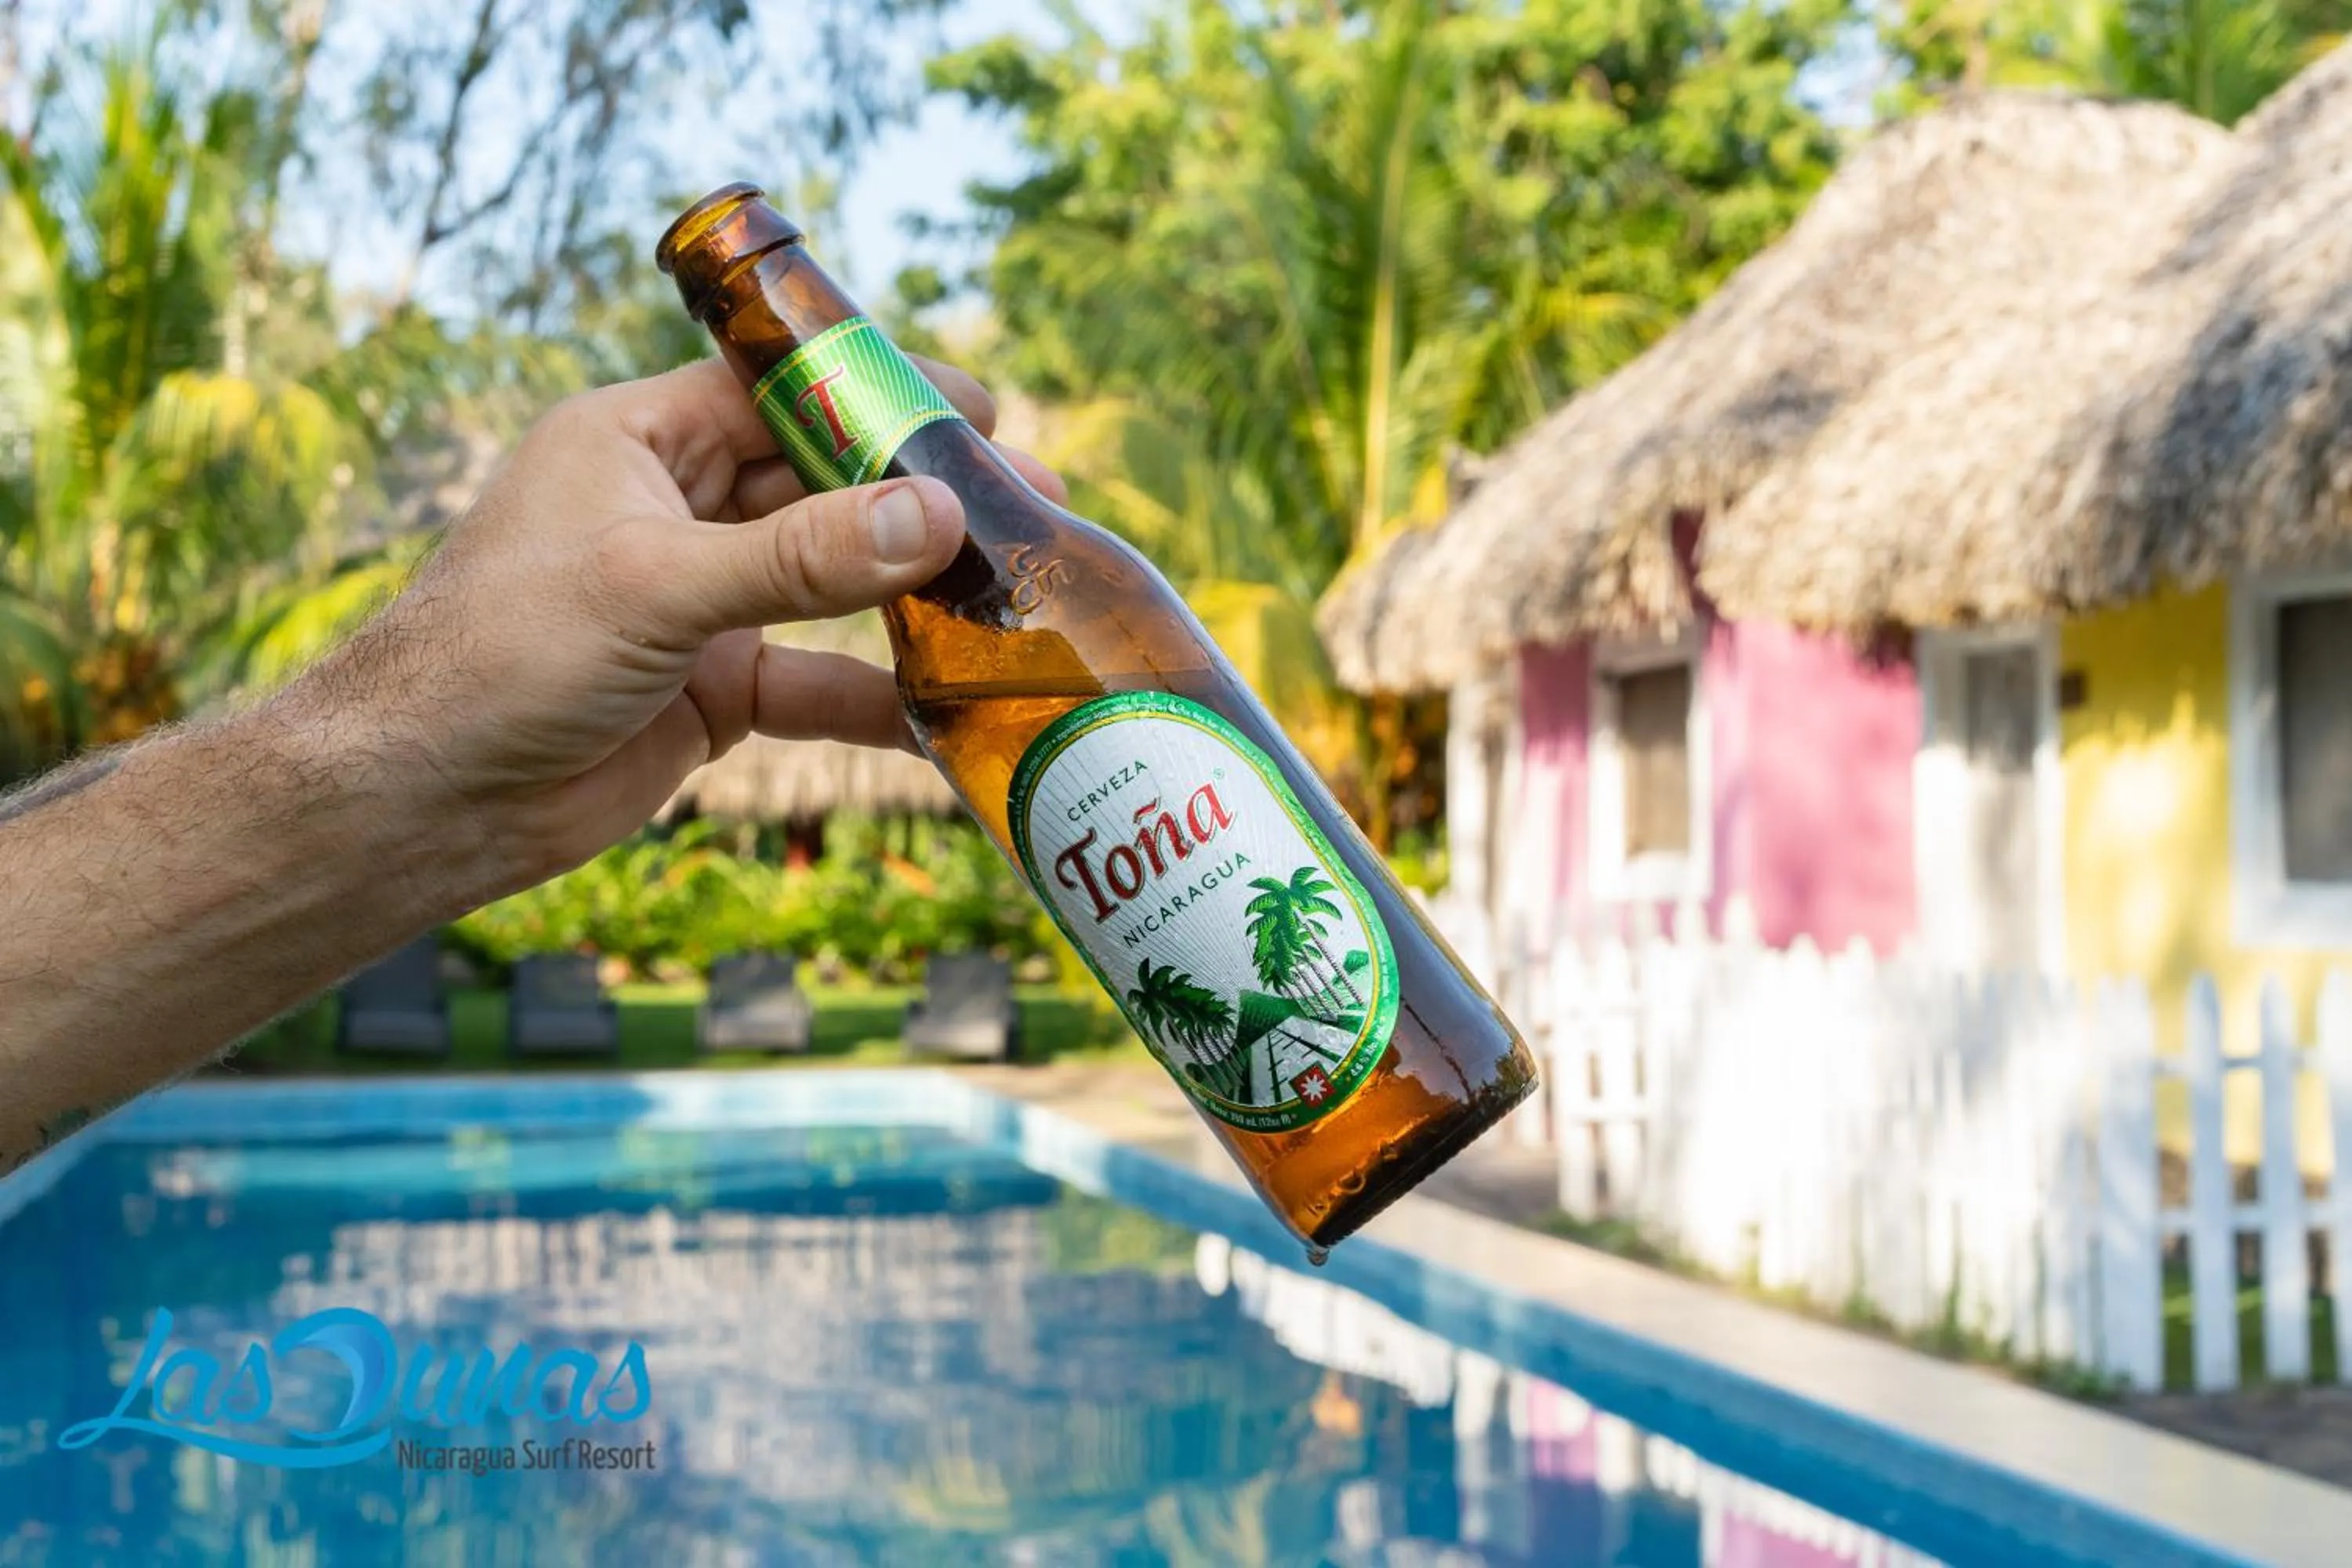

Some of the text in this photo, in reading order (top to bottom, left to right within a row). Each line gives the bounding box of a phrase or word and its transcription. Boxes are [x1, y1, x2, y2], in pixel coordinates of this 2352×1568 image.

[795, 365, 860, 460] T
[1067, 760, 1148, 822] CERVEZA
[1055, 780, 1236, 924] Toña
[1123, 851, 1252, 949] NICARAGUA
